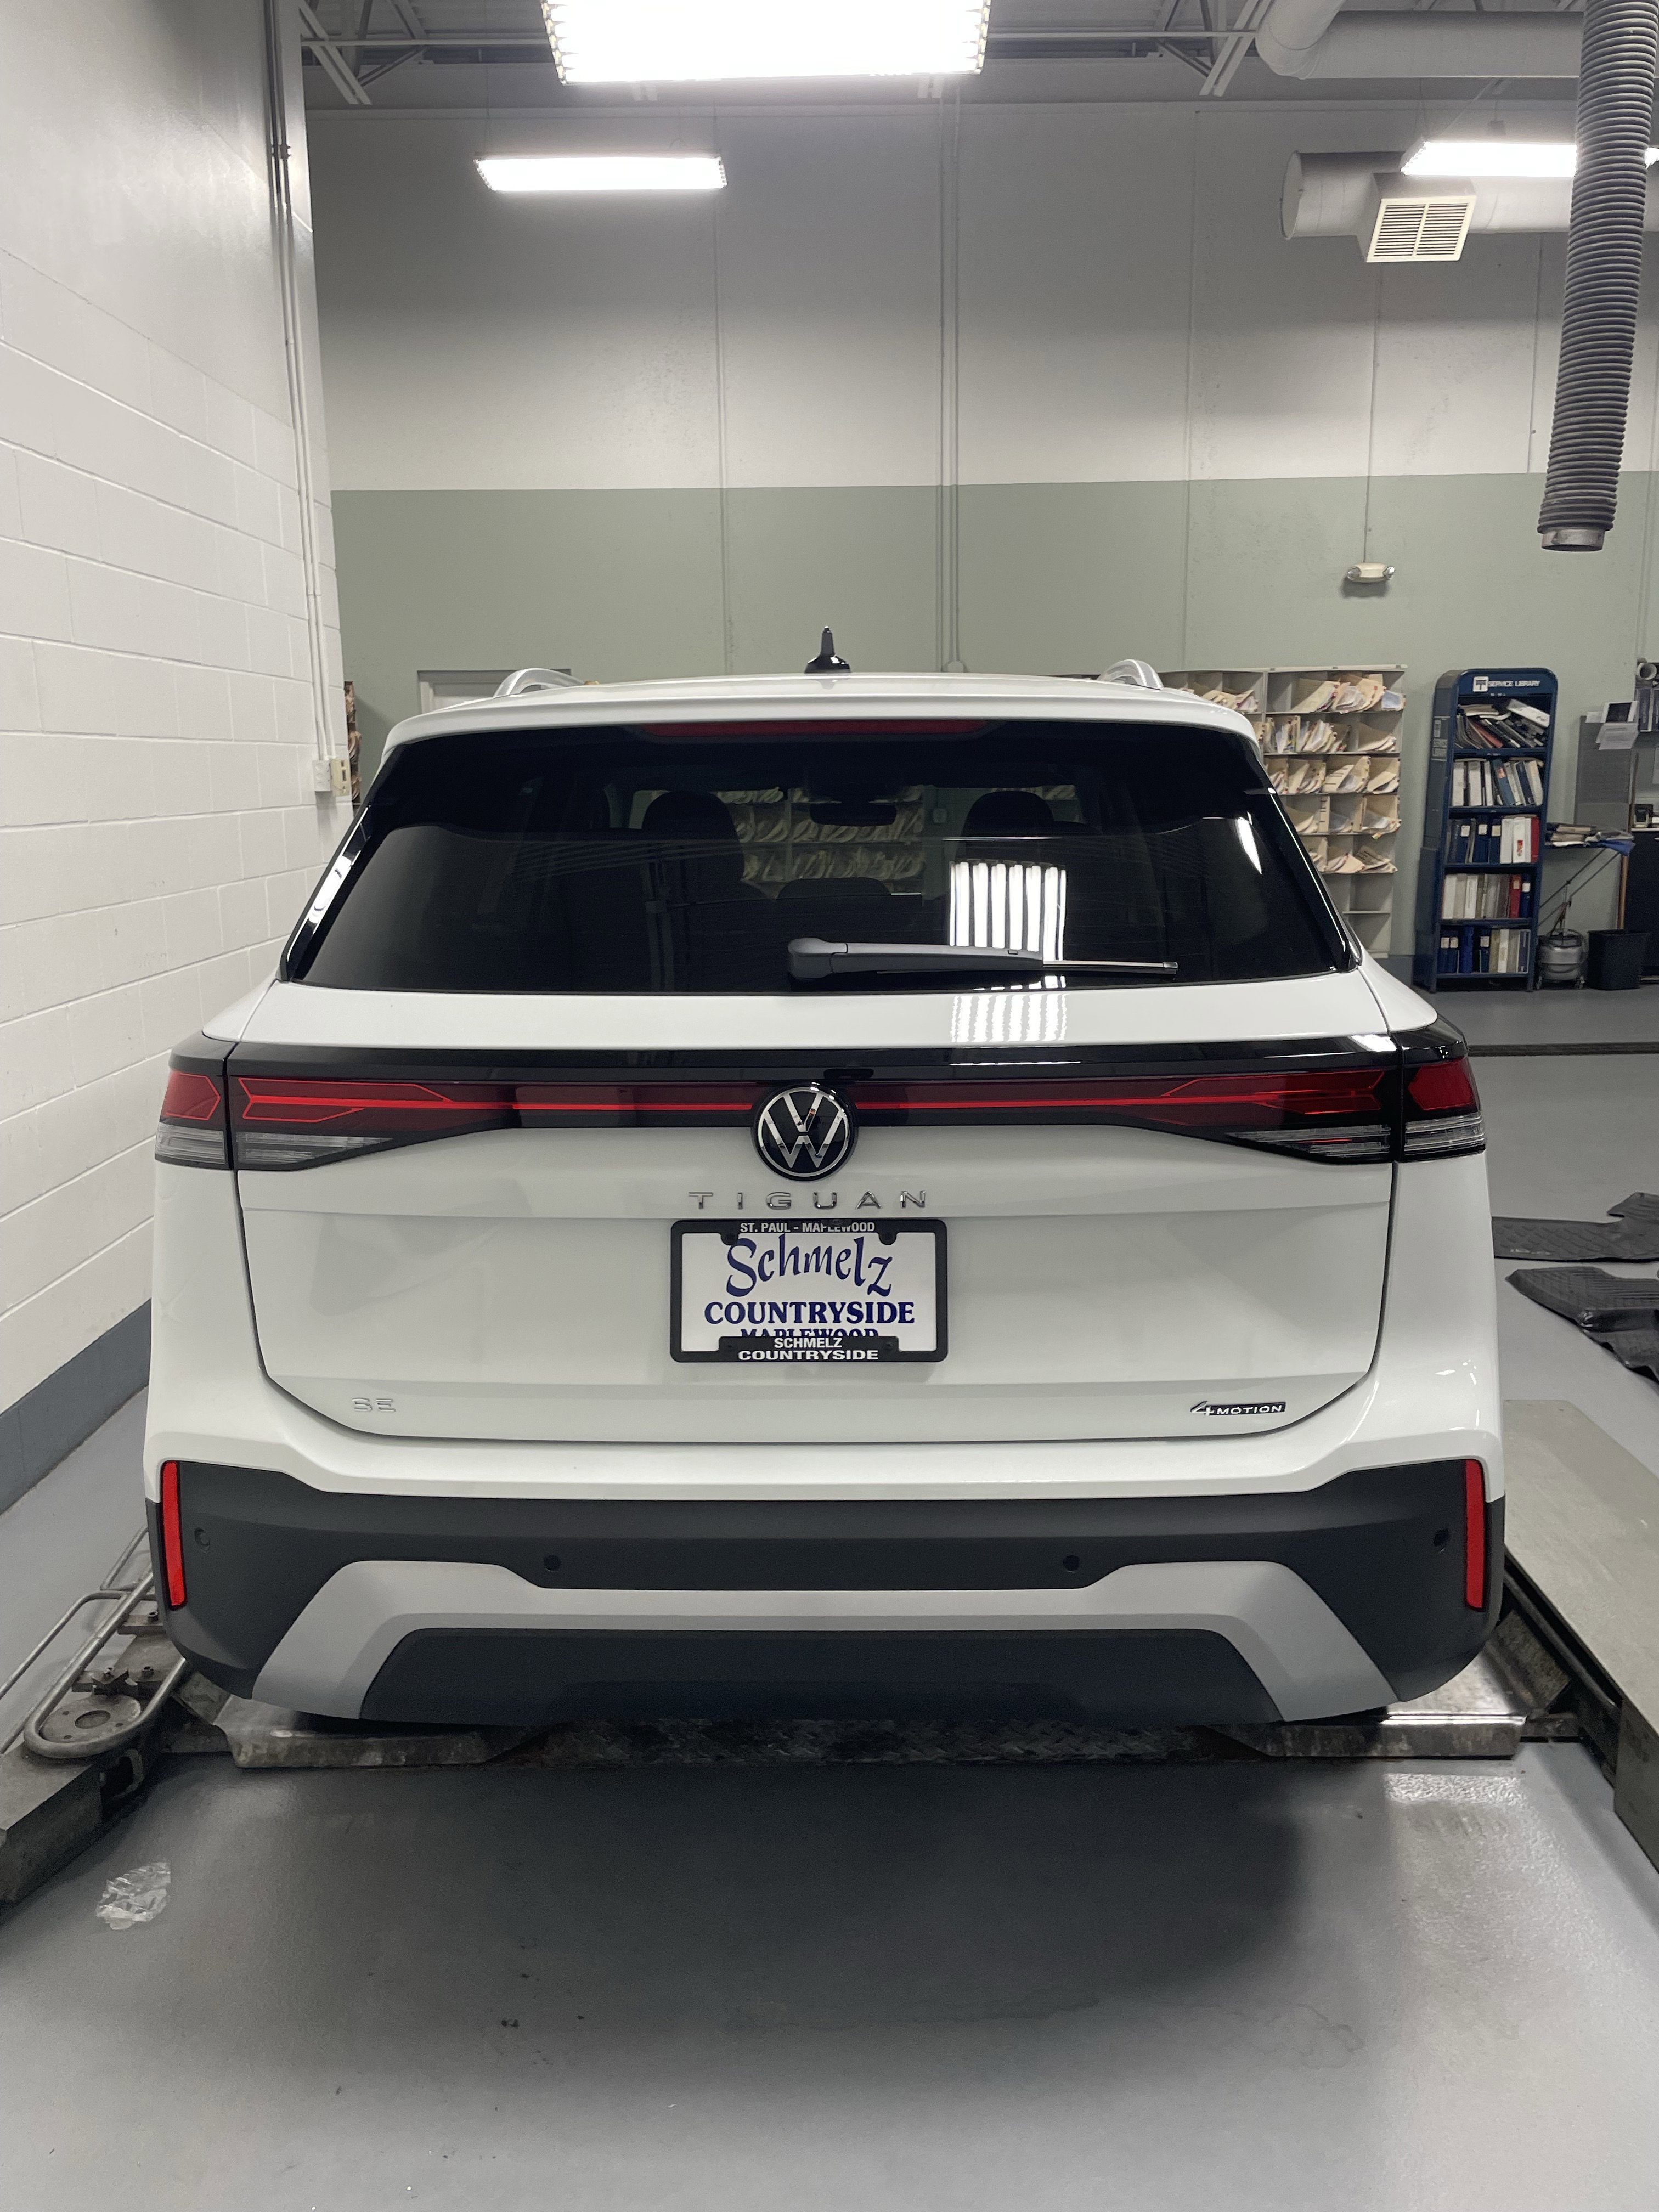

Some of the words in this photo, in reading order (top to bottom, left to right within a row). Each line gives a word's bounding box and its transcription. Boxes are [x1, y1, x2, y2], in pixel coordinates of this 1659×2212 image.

[688, 1190, 926, 1210] TIGUAN
[740, 1222, 758, 1232] ST.
[761, 1222, 791, 1232] PAUL
[726, 1233, 893, 1297] Schmelz
[704, 1302, 915, 1324] COUNTRYSIDE
[774, 1338, 843, 1349] SCHMELZ
[738, 1350, 879, 1361] COUNTRYSIDE
[352, 1397, 396, 1412] SE
[1189, 1400, 1283, 1417] 4MOTION
